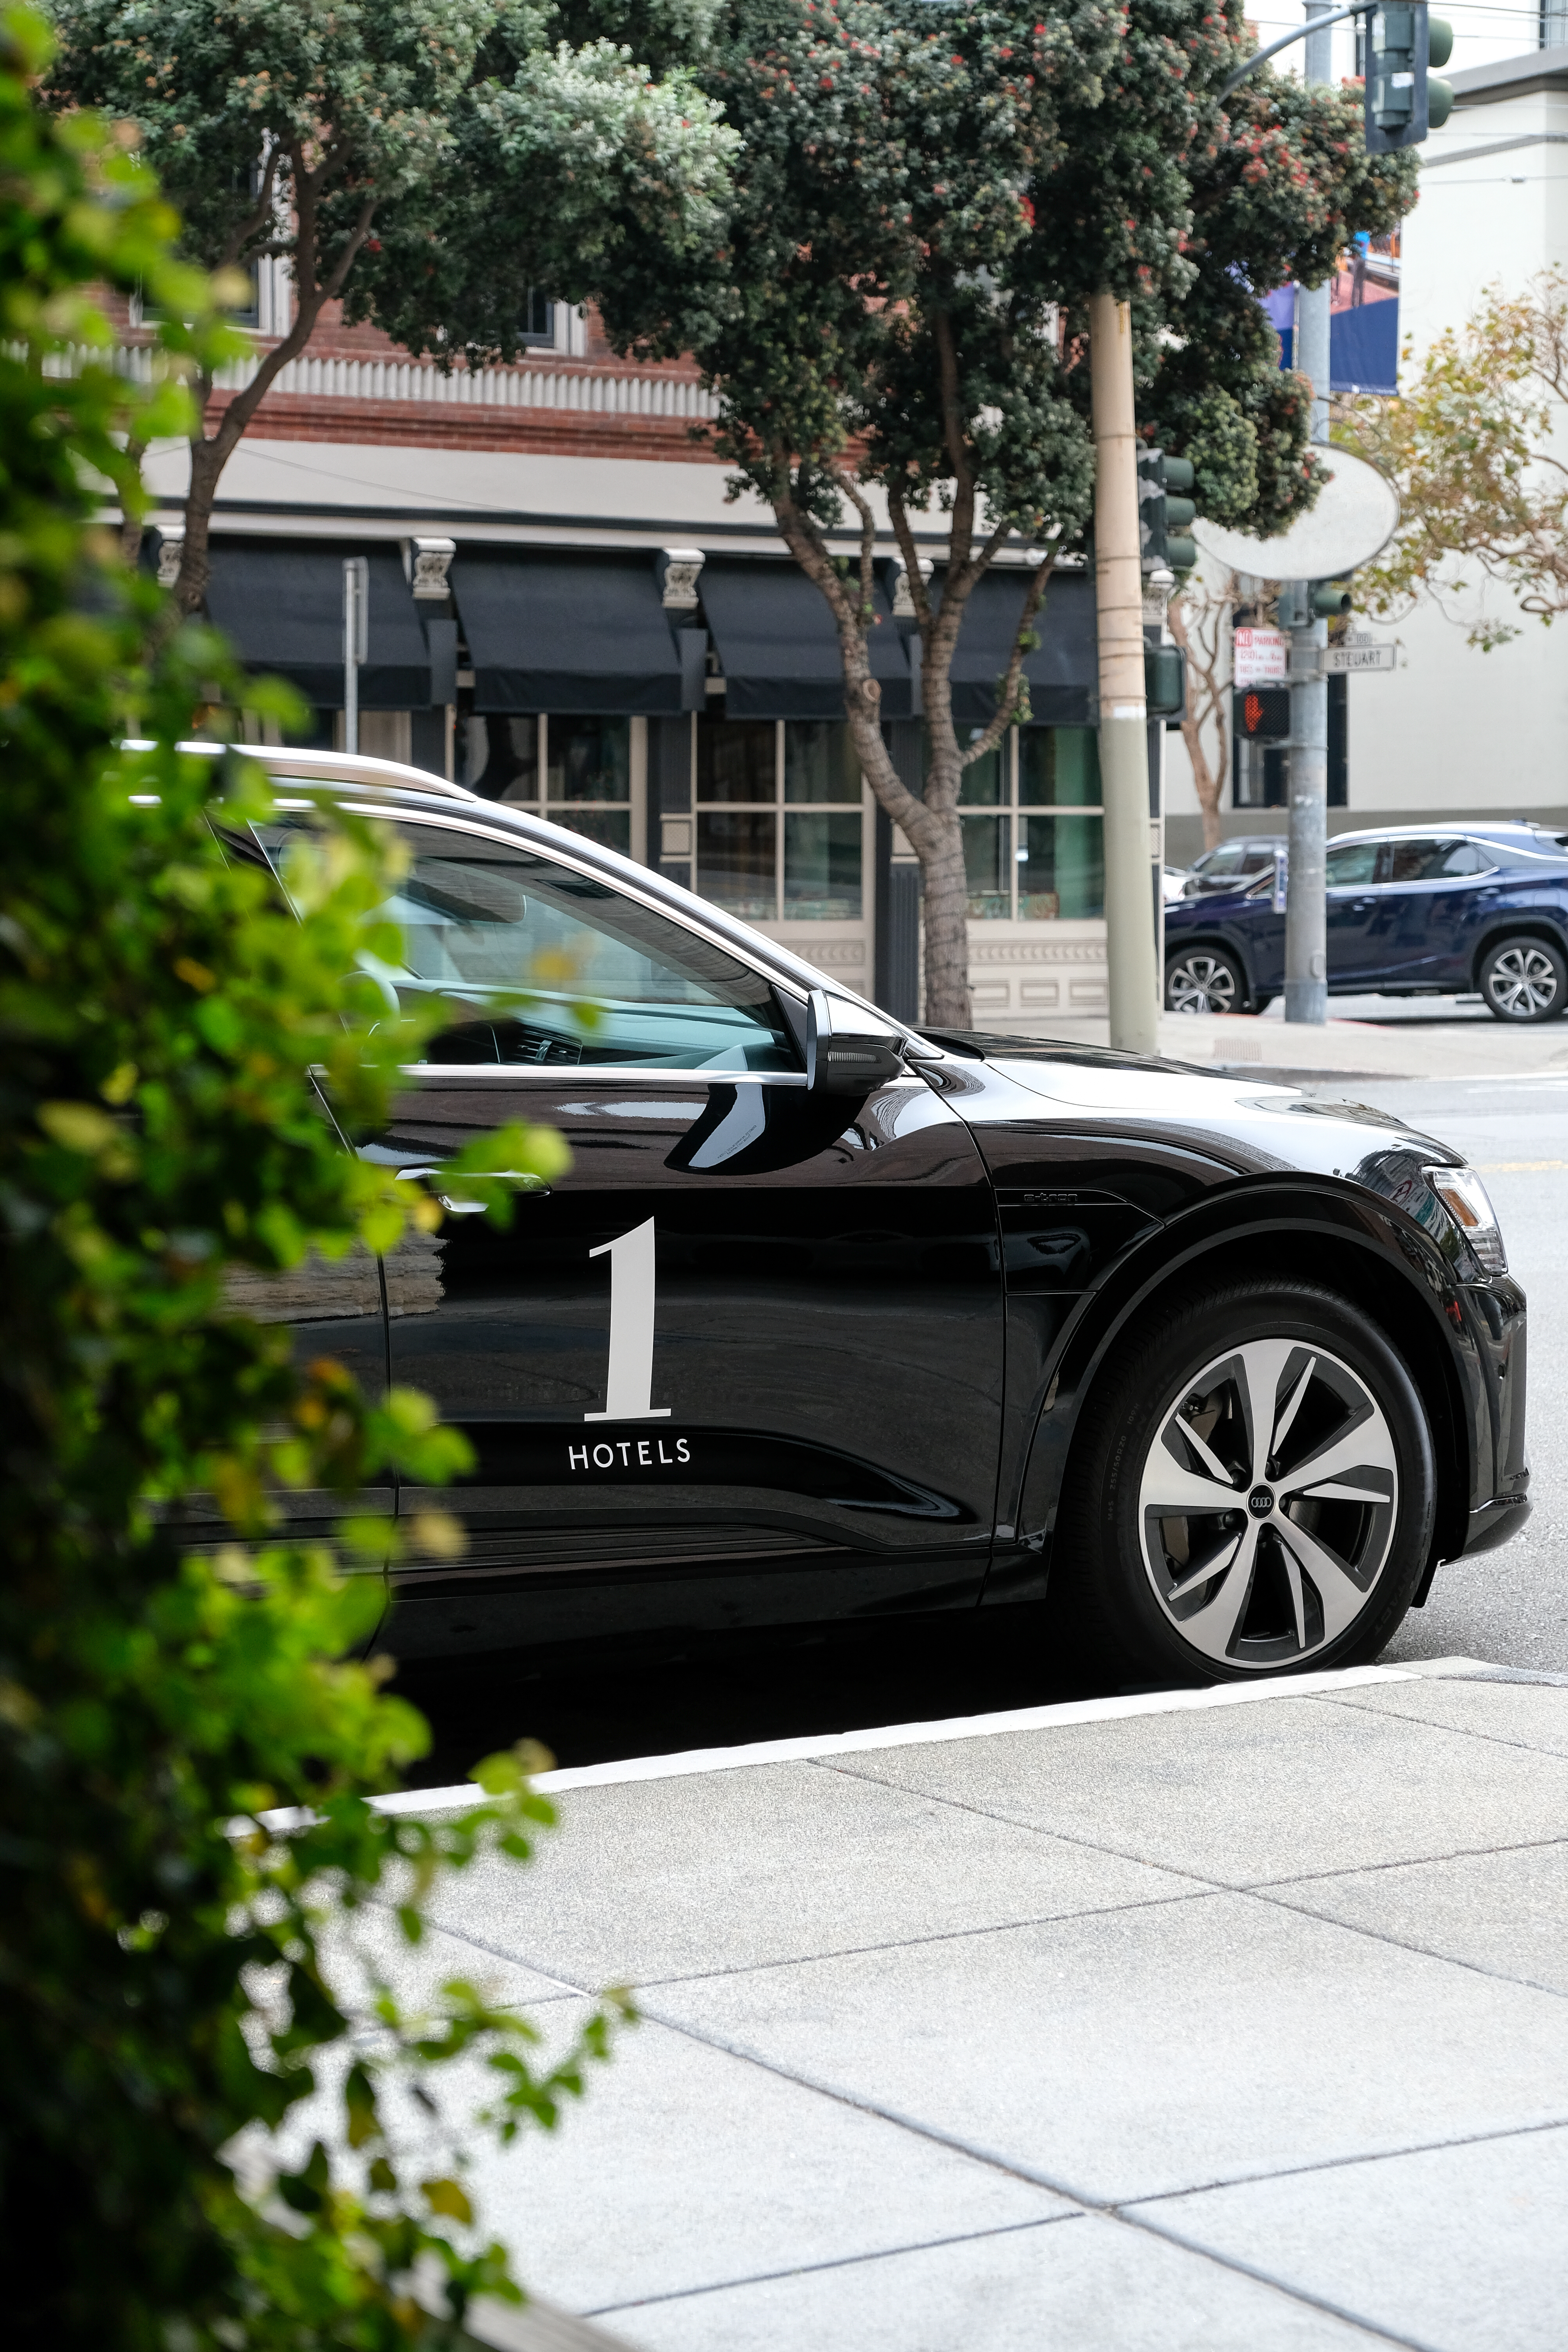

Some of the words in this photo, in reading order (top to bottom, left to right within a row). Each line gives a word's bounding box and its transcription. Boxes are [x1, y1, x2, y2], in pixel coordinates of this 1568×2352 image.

[1237, 630, 1251, 645] NO
[1333, 649, 1381, 668] STEUART
[1024, 1192, 1078, 1202] e-tron
[584, 1216, 671, 1422] 1
[569, 1439, 690, 1470] HOTELS
[1110, 1435, 1127, 1490] 255/50R20
[1127, 1403, 1140, 1425] 109H
